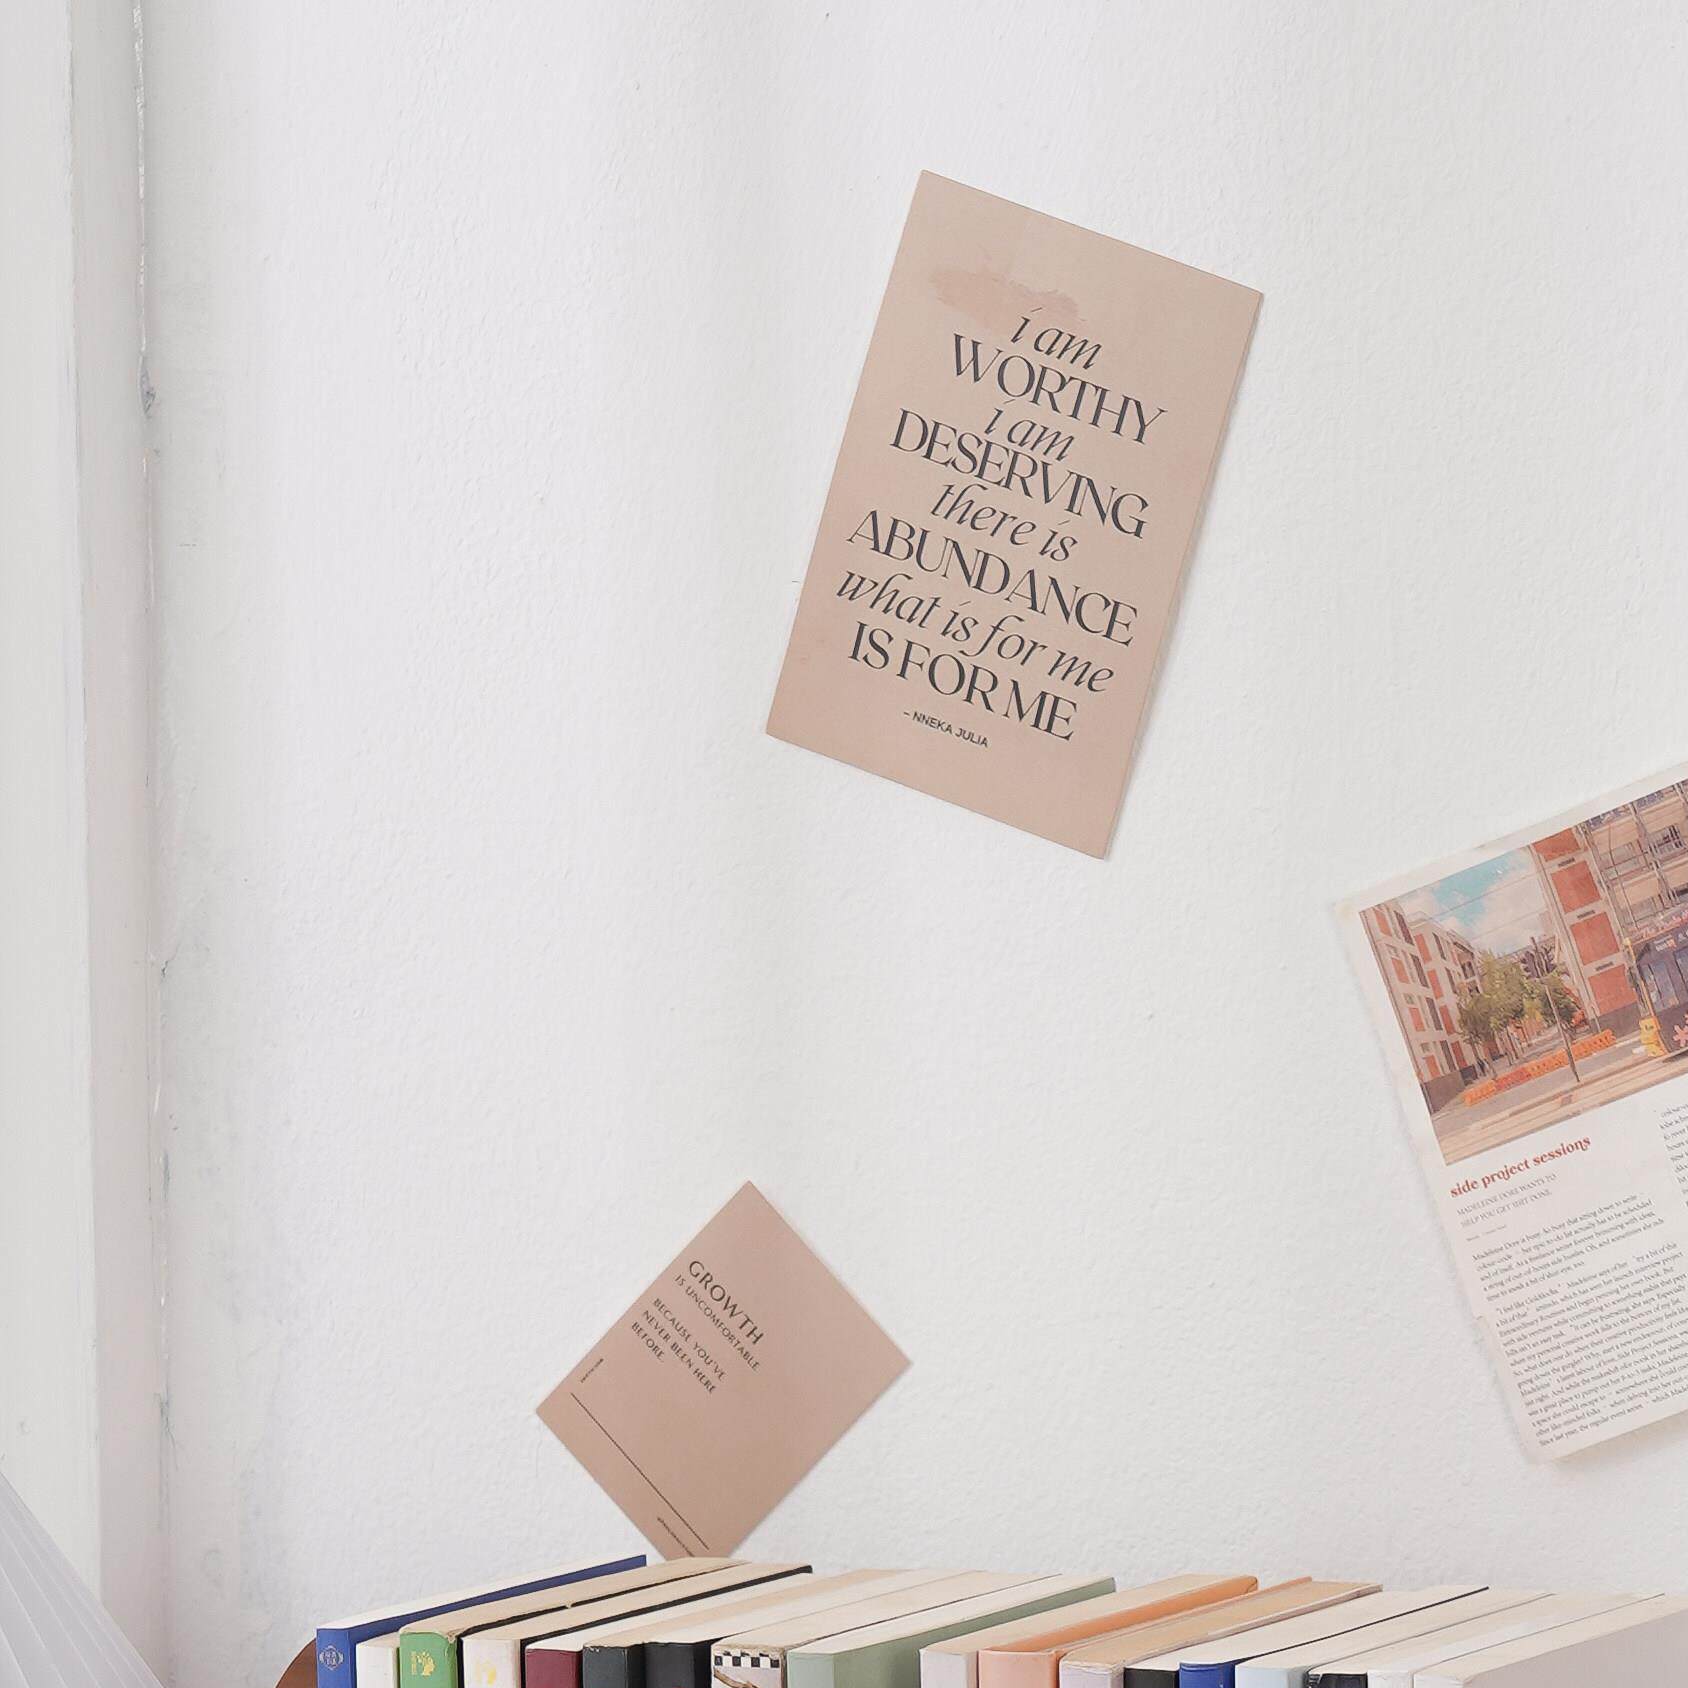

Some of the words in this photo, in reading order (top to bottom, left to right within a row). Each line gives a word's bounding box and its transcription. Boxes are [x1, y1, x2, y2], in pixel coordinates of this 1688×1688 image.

[1011, 307, 1042, 344] i
[1034, 323, 1101, 370] am
[953, 334, 1166, 444] WORTHY
[985, 399, 1014, 435] i
[1008, 416, 1074, 461] am
[891, 410, 1146, 538] DESERVING
[930, 483, 1035, 546] there
[1040, 523, 1077, 562] is
[847, 511, 1137, 645] ABUNDANCE
[837, 571, 940, 629] what
[942, 603, 971, 643] is
[964, 614, 1045, 667] for
[1050, 650, 1114, 692] me
[849, 622, 893, 669] IS
[897, 642, 999, 712] FOR
[1003, 681, 1077, 740] ME
[913, 711, 954, 736] NNEKA
[954, 727, 988, 748] JULIA
[1451, 1176, 1478, 1198] side
[1481, 1157, 1529, 1187] project
[1533, 1135, 1591, 1166] sessions
[675, 1274, 686, 1286] IS
[688, 1261, 763, 1345] GROWTH
[643, 1310, 670, 1340] NEVER
[672, 1343, 693, 1368] BEEN
[694, 1368, 716, 1394] HERE
[653, 1299, 691, 1343] BECAUSE
